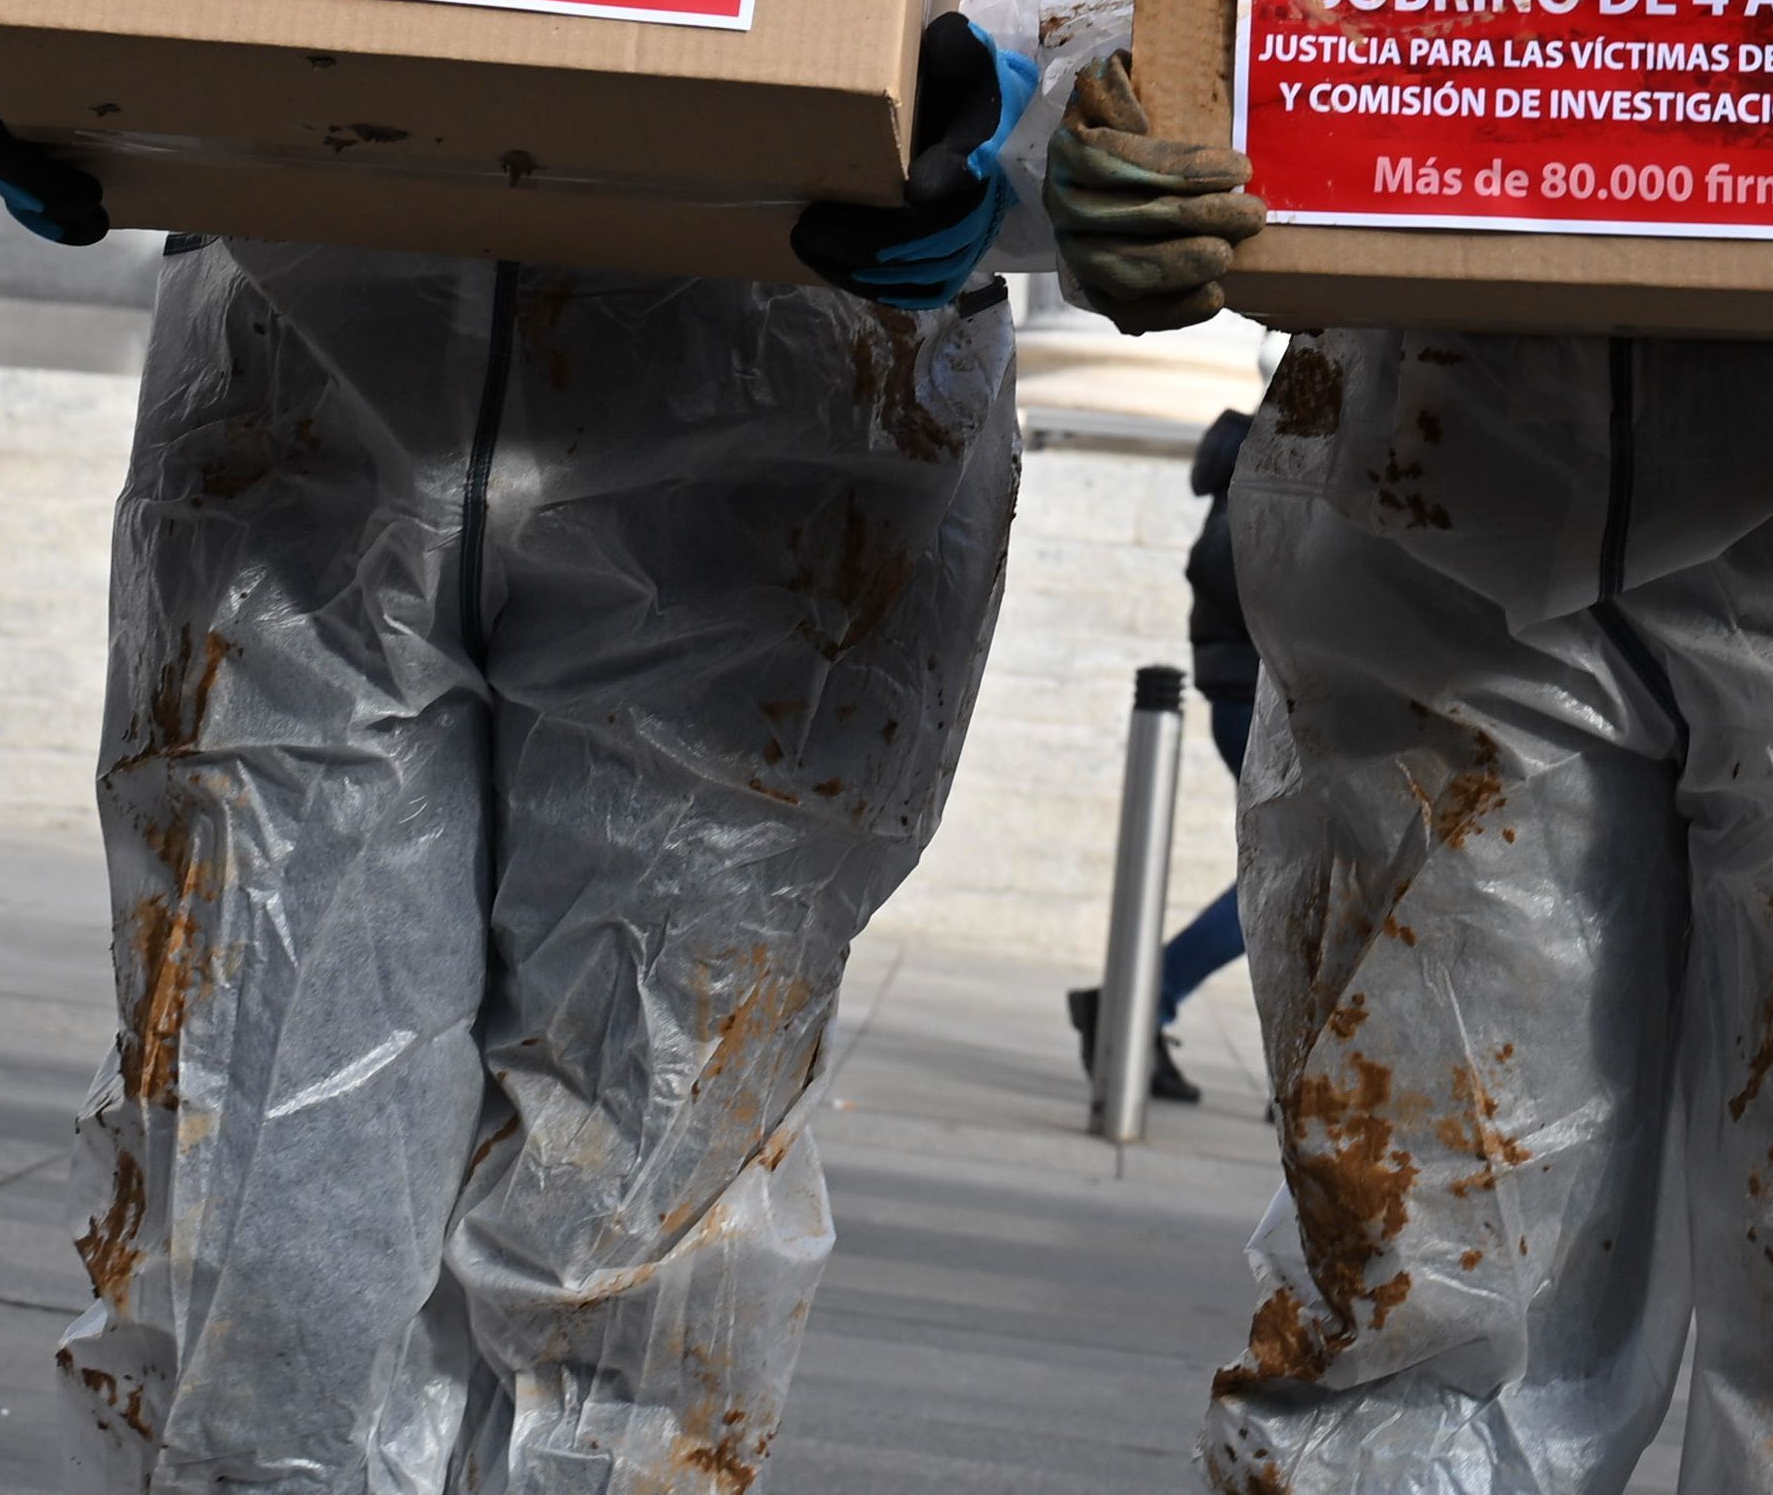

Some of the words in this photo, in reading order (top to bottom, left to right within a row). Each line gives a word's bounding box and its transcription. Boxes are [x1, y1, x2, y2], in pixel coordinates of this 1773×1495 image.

[1258, 34, 1401, 65] JUSTICIA
[1410, 38, 1495, 67] PARA
[1504, 40, 1564, 69] LAS
[1570, 36, 1730, 72] VÍCTIMAS
[1279, 82, 1302, 111] Y
[1309, 81, 1486, 117] COMISIÓN
[1495, 88, 1541, 118] DE
[1374, 156, 1462, 196] Más
[1474, 158, 1529, 198] de
[1541, 162, 1694, 202] 80.000
